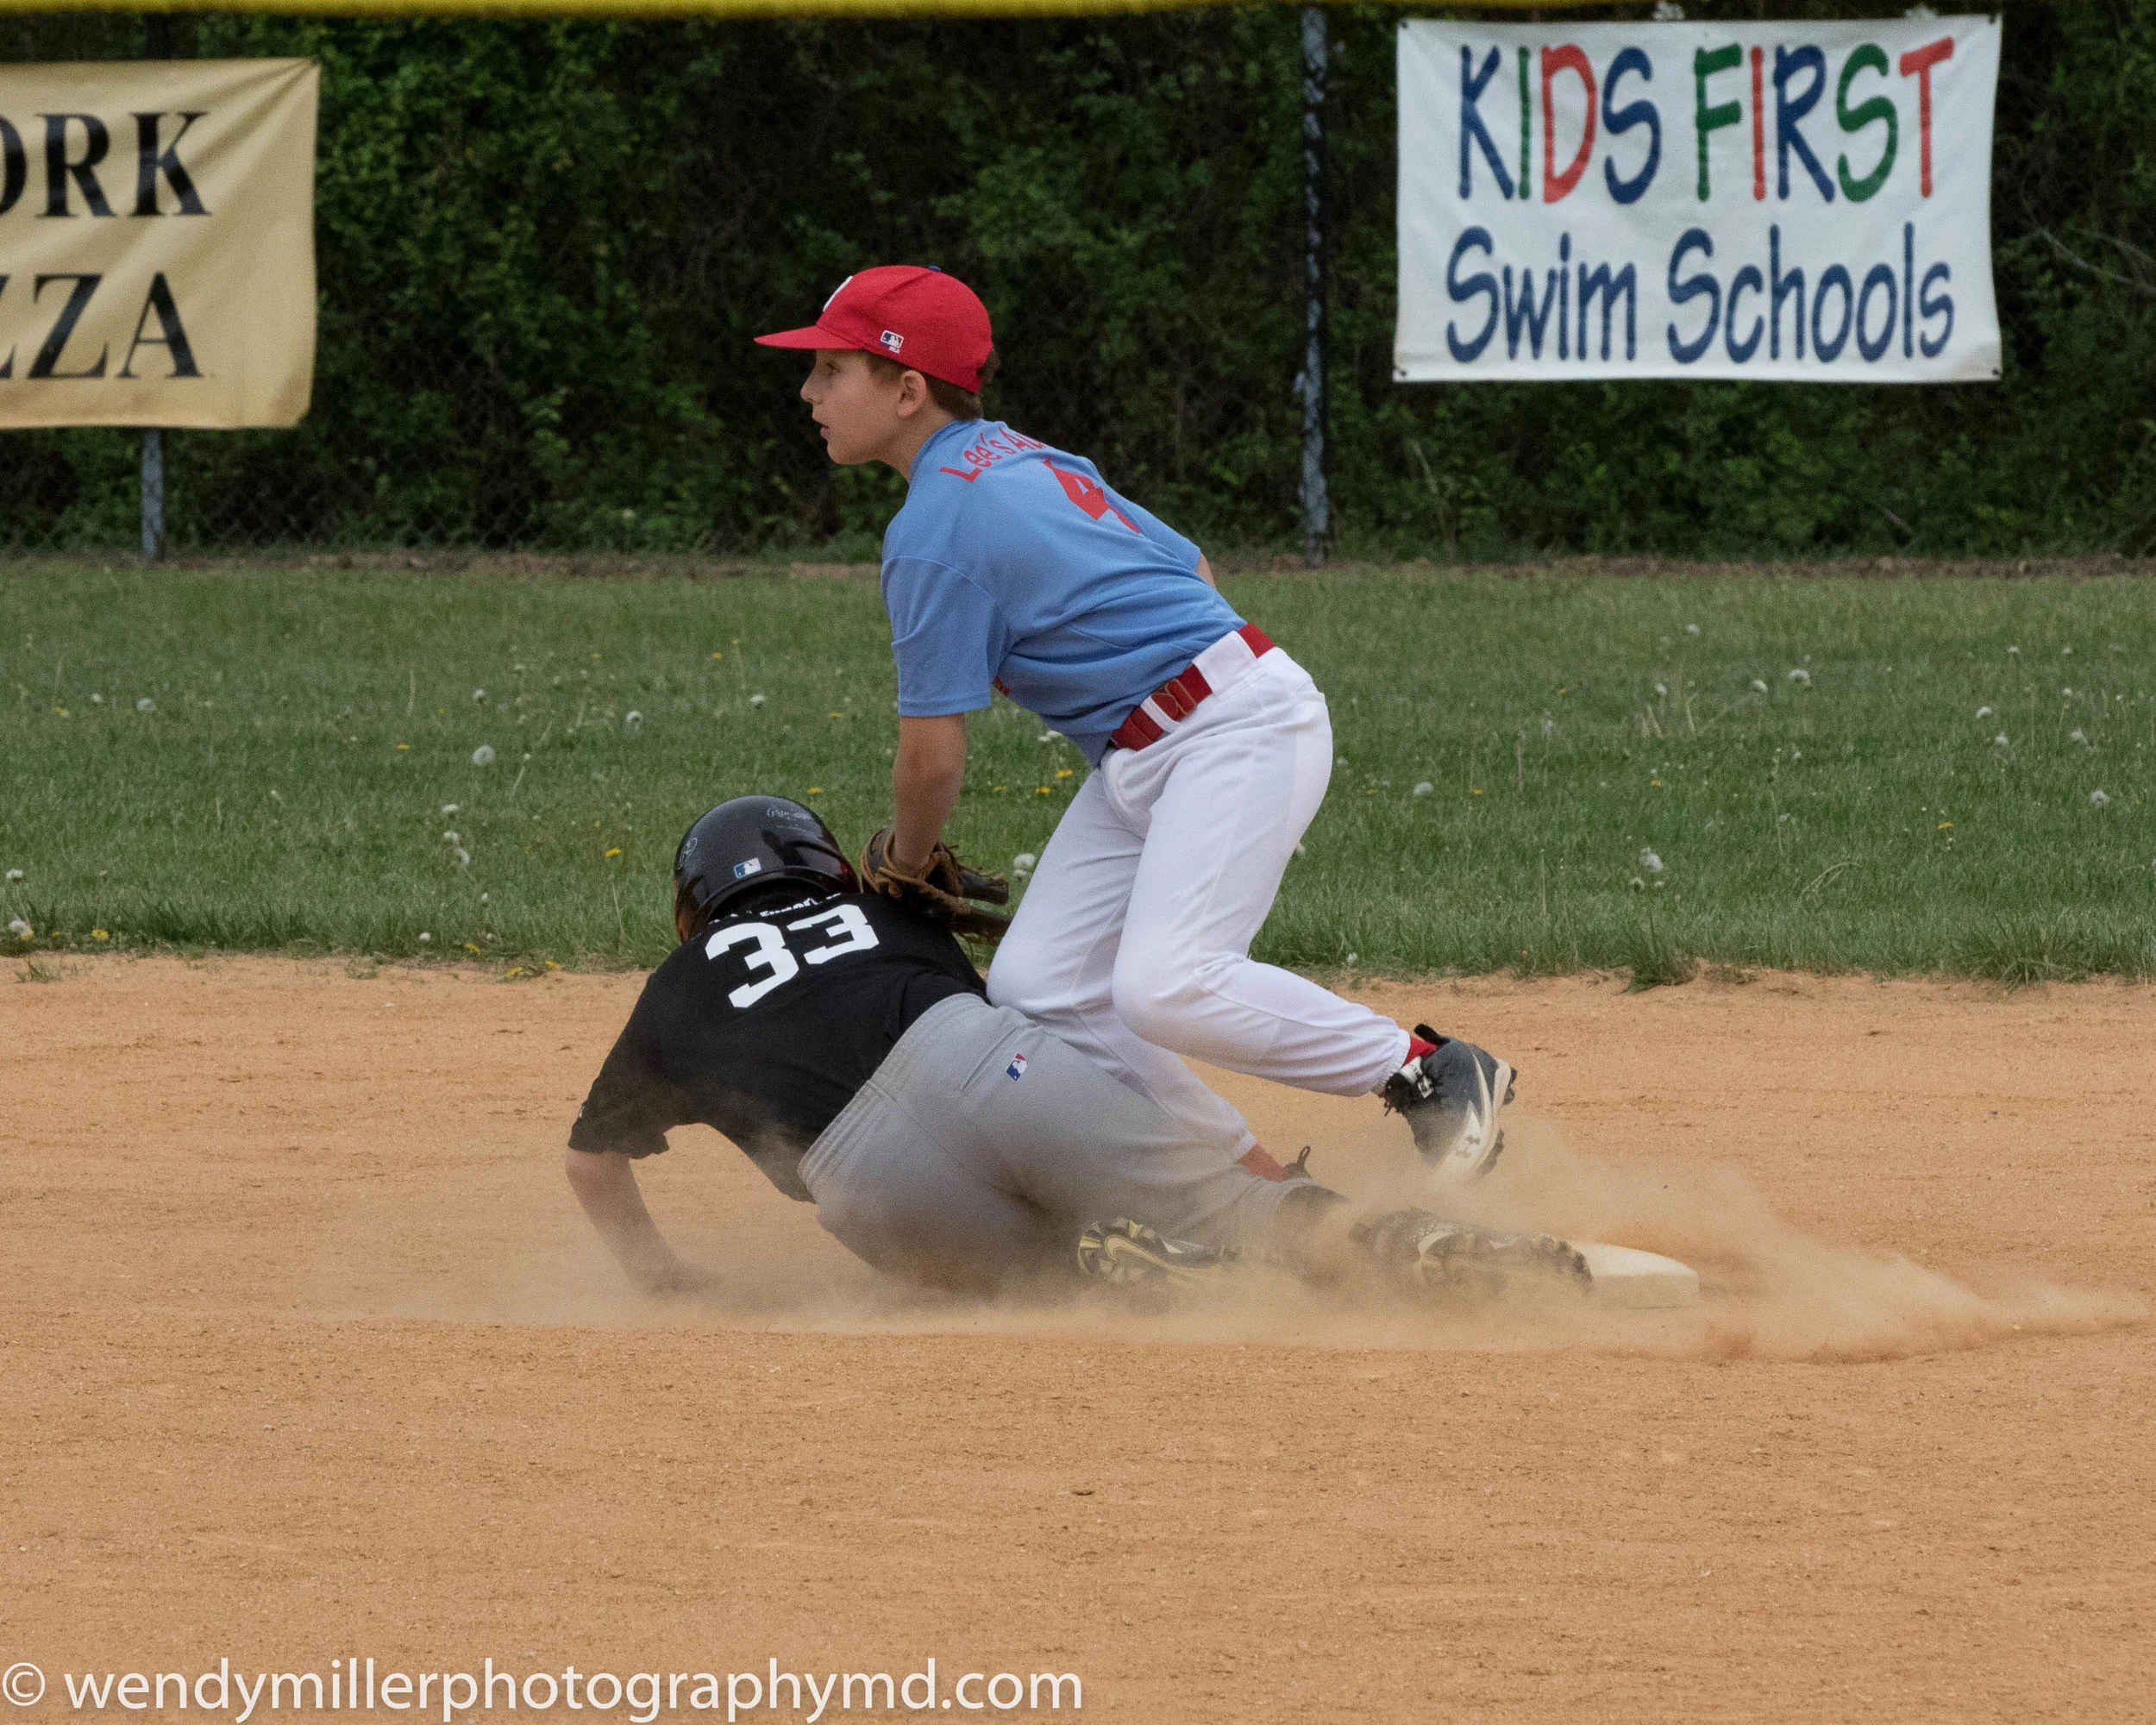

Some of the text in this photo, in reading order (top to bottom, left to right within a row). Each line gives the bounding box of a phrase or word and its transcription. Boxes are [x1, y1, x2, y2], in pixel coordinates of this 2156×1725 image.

[1459, 37, 1955, 204] KIDS FIRST
[0, 272, 203, 380] ZA
[1446, 222, 1955, 364] Swim Schools
[1042, 457, 1139, 534] 4
[705, 903, 880, 1008] 33
